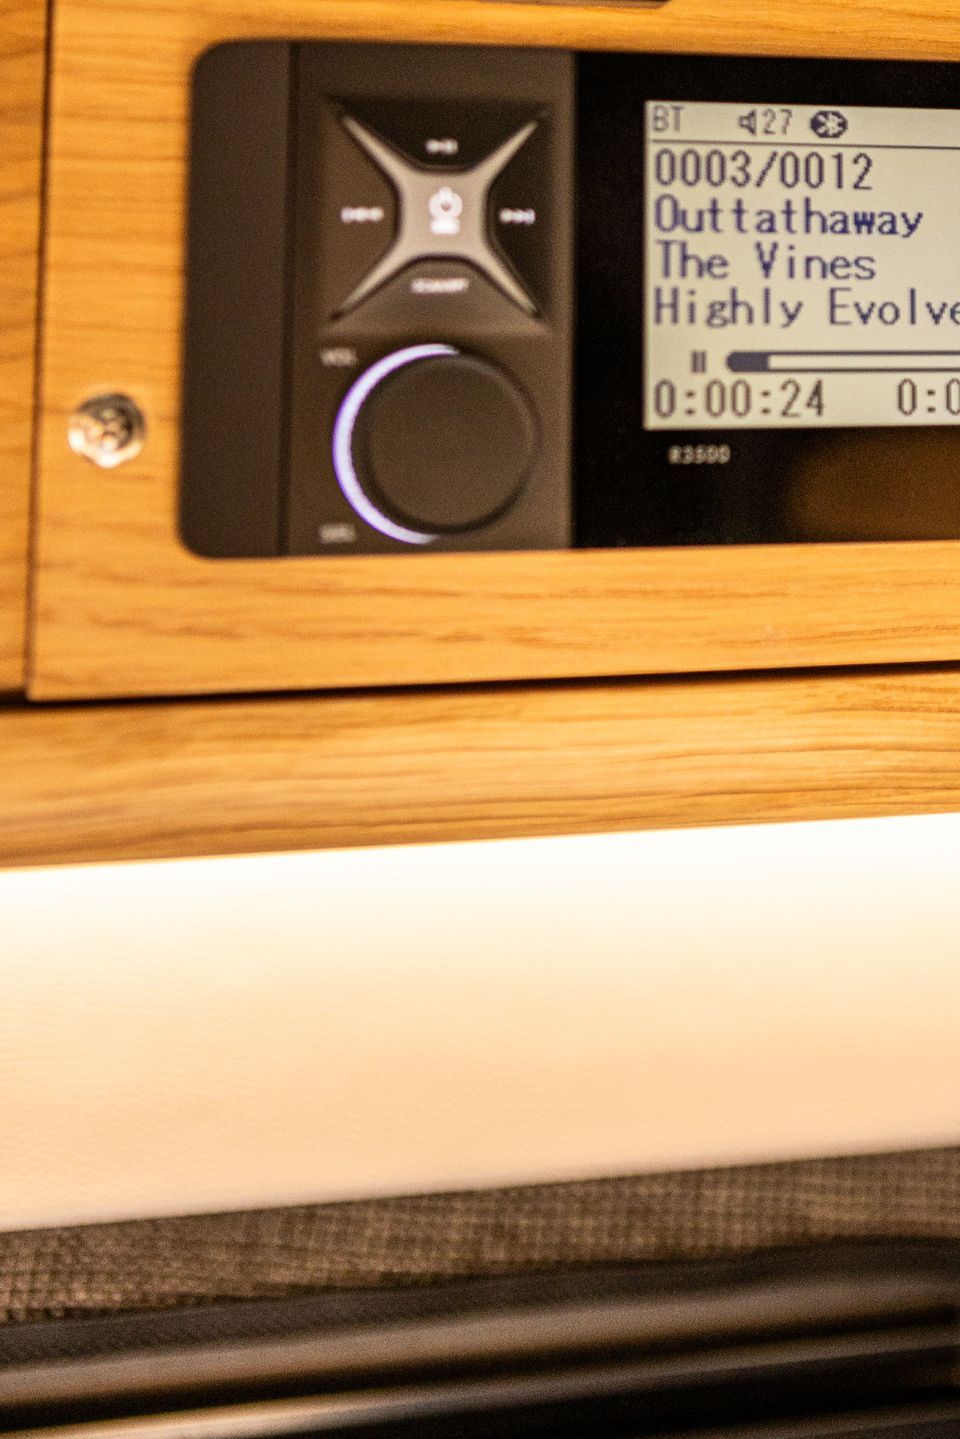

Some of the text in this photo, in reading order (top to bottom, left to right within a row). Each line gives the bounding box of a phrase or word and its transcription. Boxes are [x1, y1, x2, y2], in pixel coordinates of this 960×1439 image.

[652, 106, 794, 135] BT 27
[654, 148, 874, 191] 0003/0012
[653, 196, 924, 239] Outtathaway
[655, 241, 877, 281] The Vines
[653, 288, 804, 329] Highly
[654, 379, 826, 419] 0:00:24
